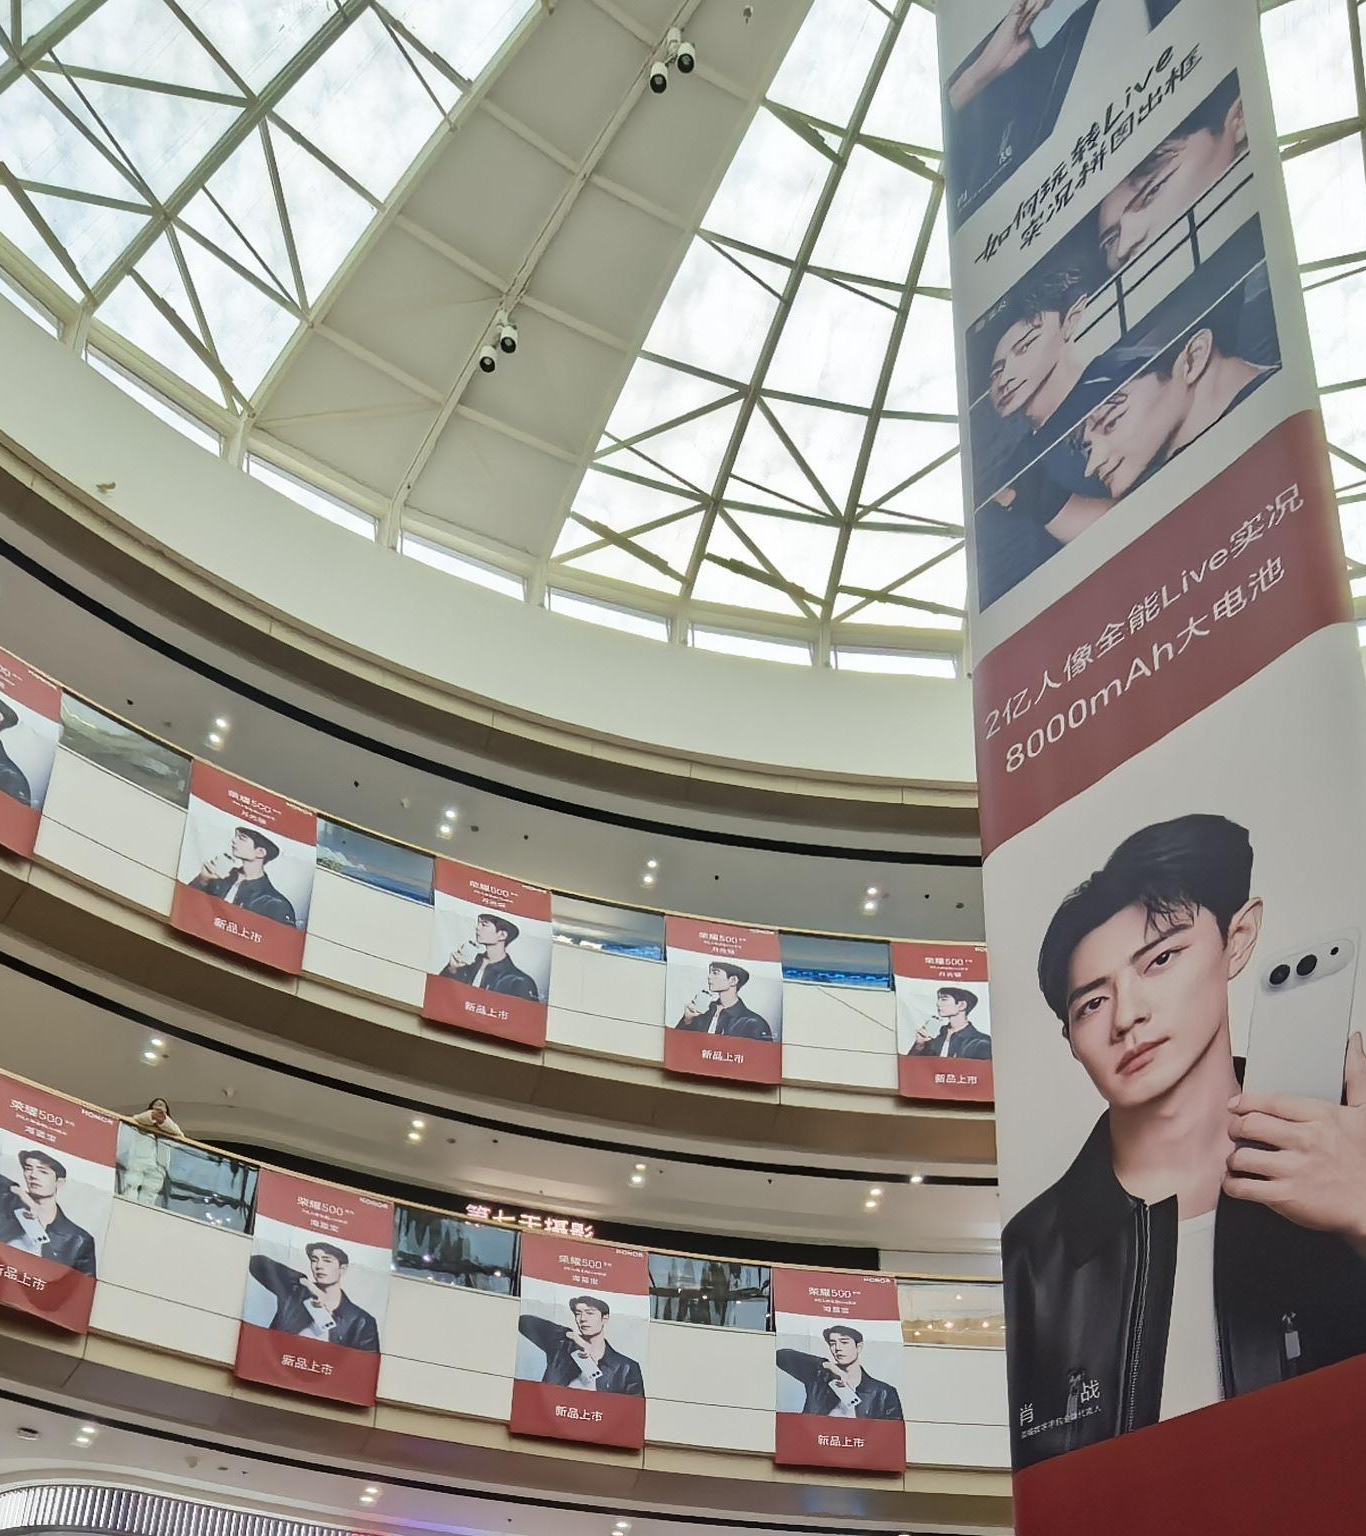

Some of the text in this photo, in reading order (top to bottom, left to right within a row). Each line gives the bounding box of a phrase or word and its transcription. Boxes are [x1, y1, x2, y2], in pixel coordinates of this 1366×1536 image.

[985, 482, 1305, 741] 2亿人像全能Live实况
[1005, 555, 1286, 774] 8000mAh大电池
[213, 917, 263, 943] 新品上市
[465, 1001, 510, 1020] 新品上市
[701, 1050, 745, 1065] 新品上市
[934, 1074, 978, 1085] 新品上市
[281, 1353, 334, 1378] 新品上市
[555, 1404, 603, 1424] 新品上市
[817, 1434, 866, 1448] 新品上市
